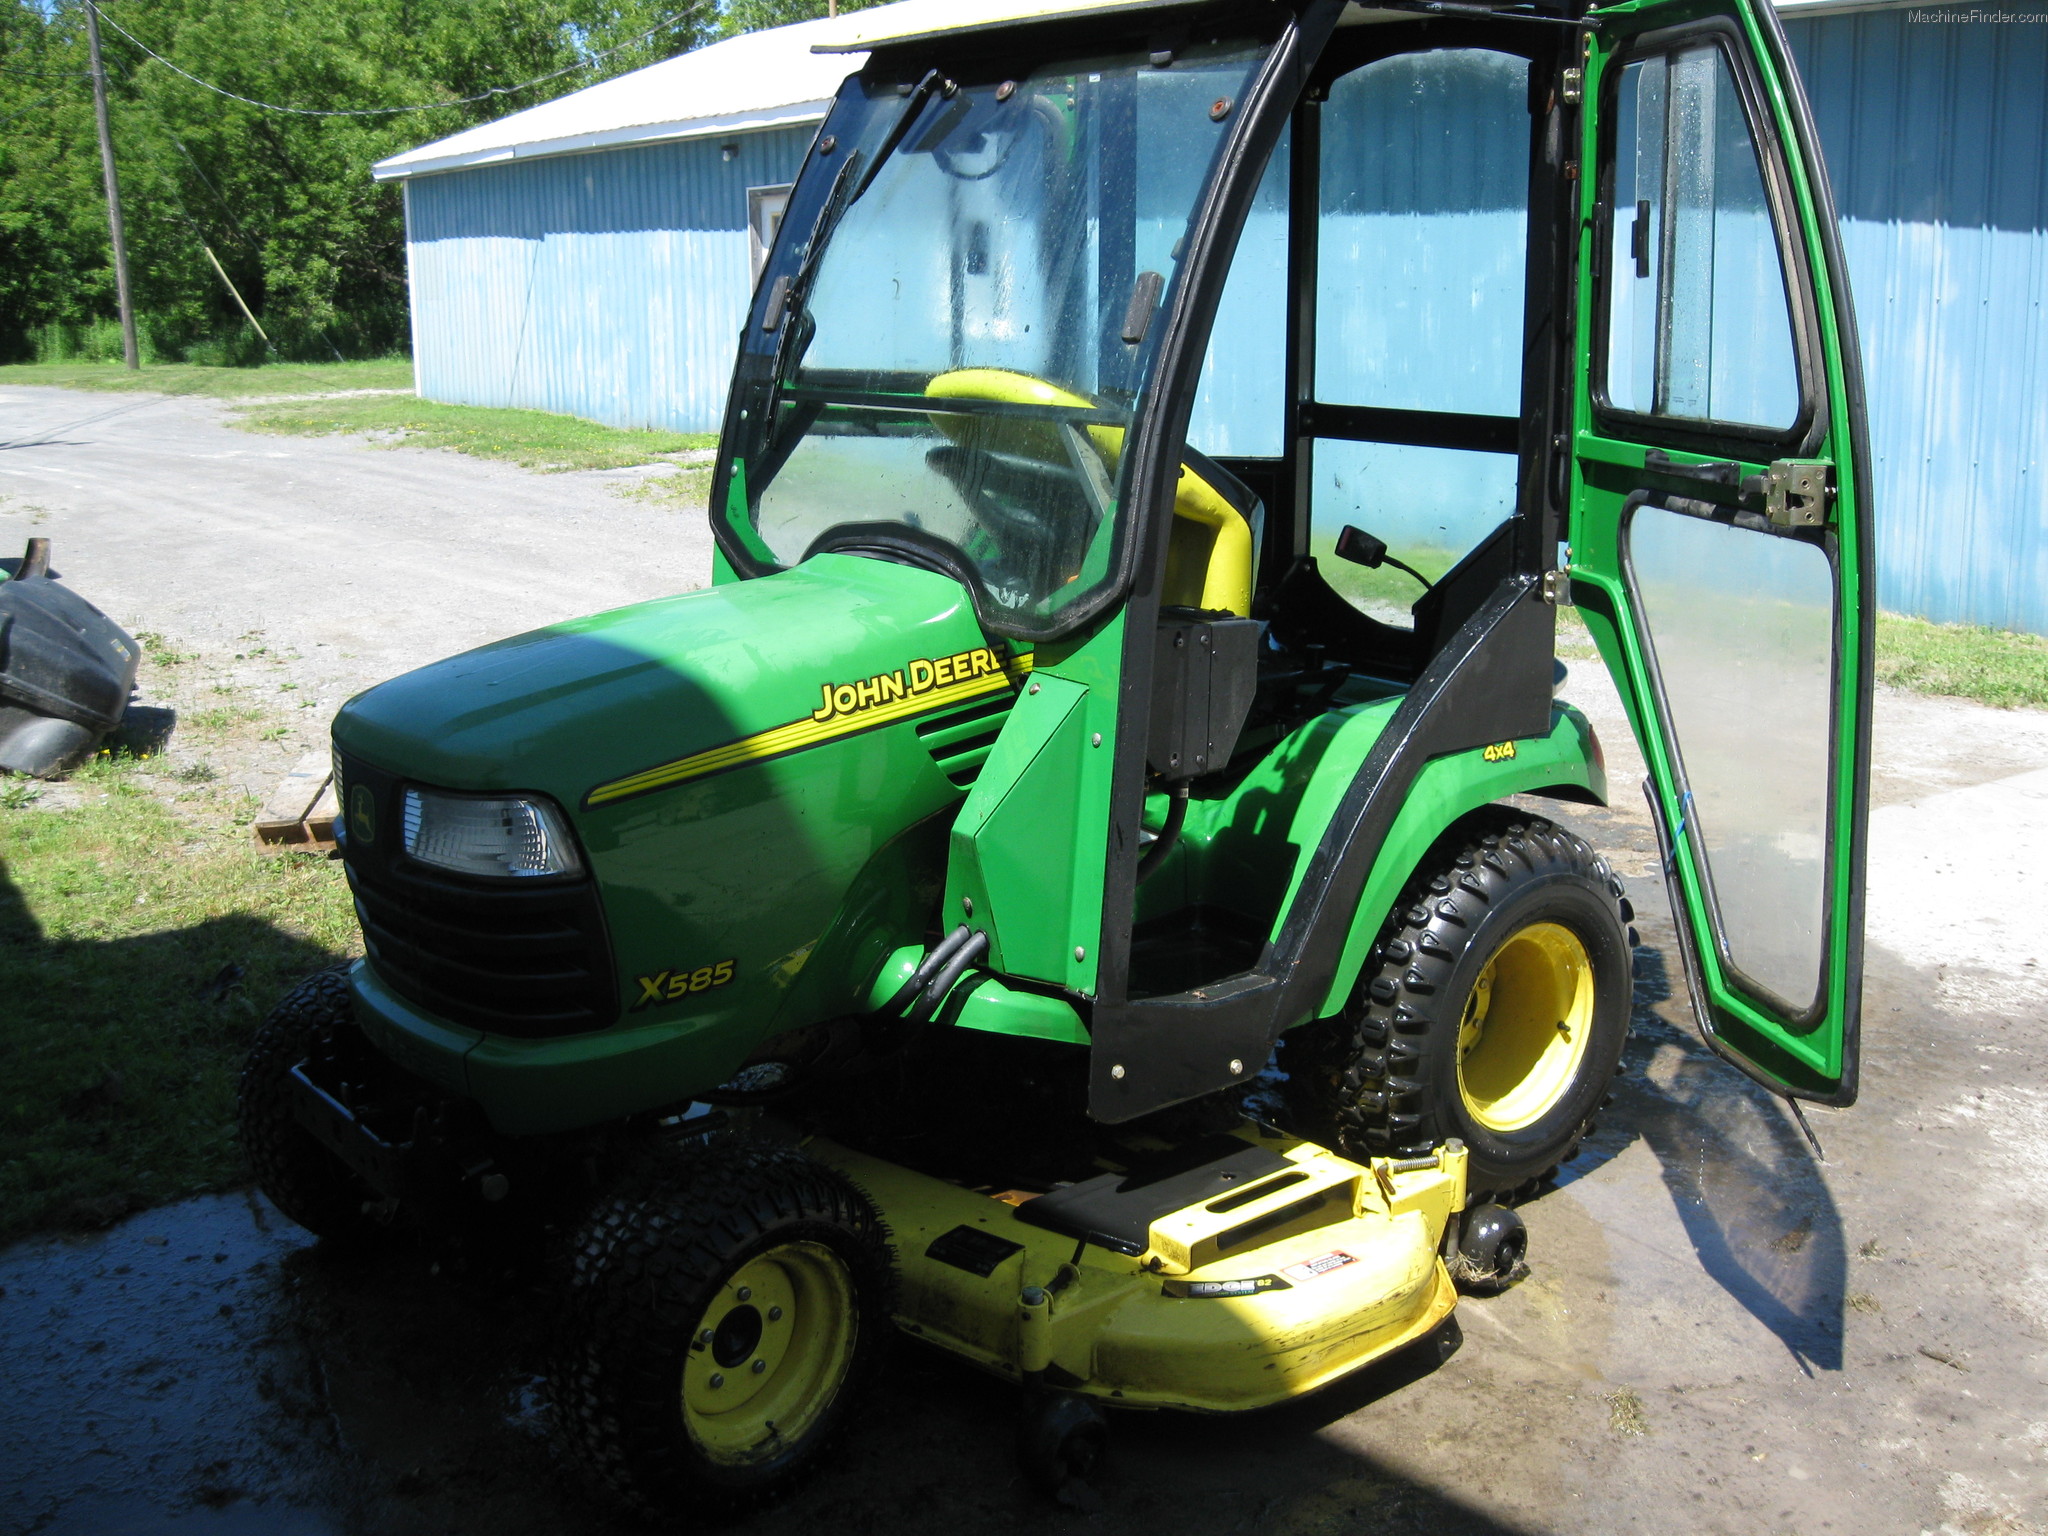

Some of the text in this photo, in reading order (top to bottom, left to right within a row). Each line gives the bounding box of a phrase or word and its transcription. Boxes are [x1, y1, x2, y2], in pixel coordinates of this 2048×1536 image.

[814, 643, 1008, 721] JOHN DEERE
[631, 958, 735, 1009] X585
